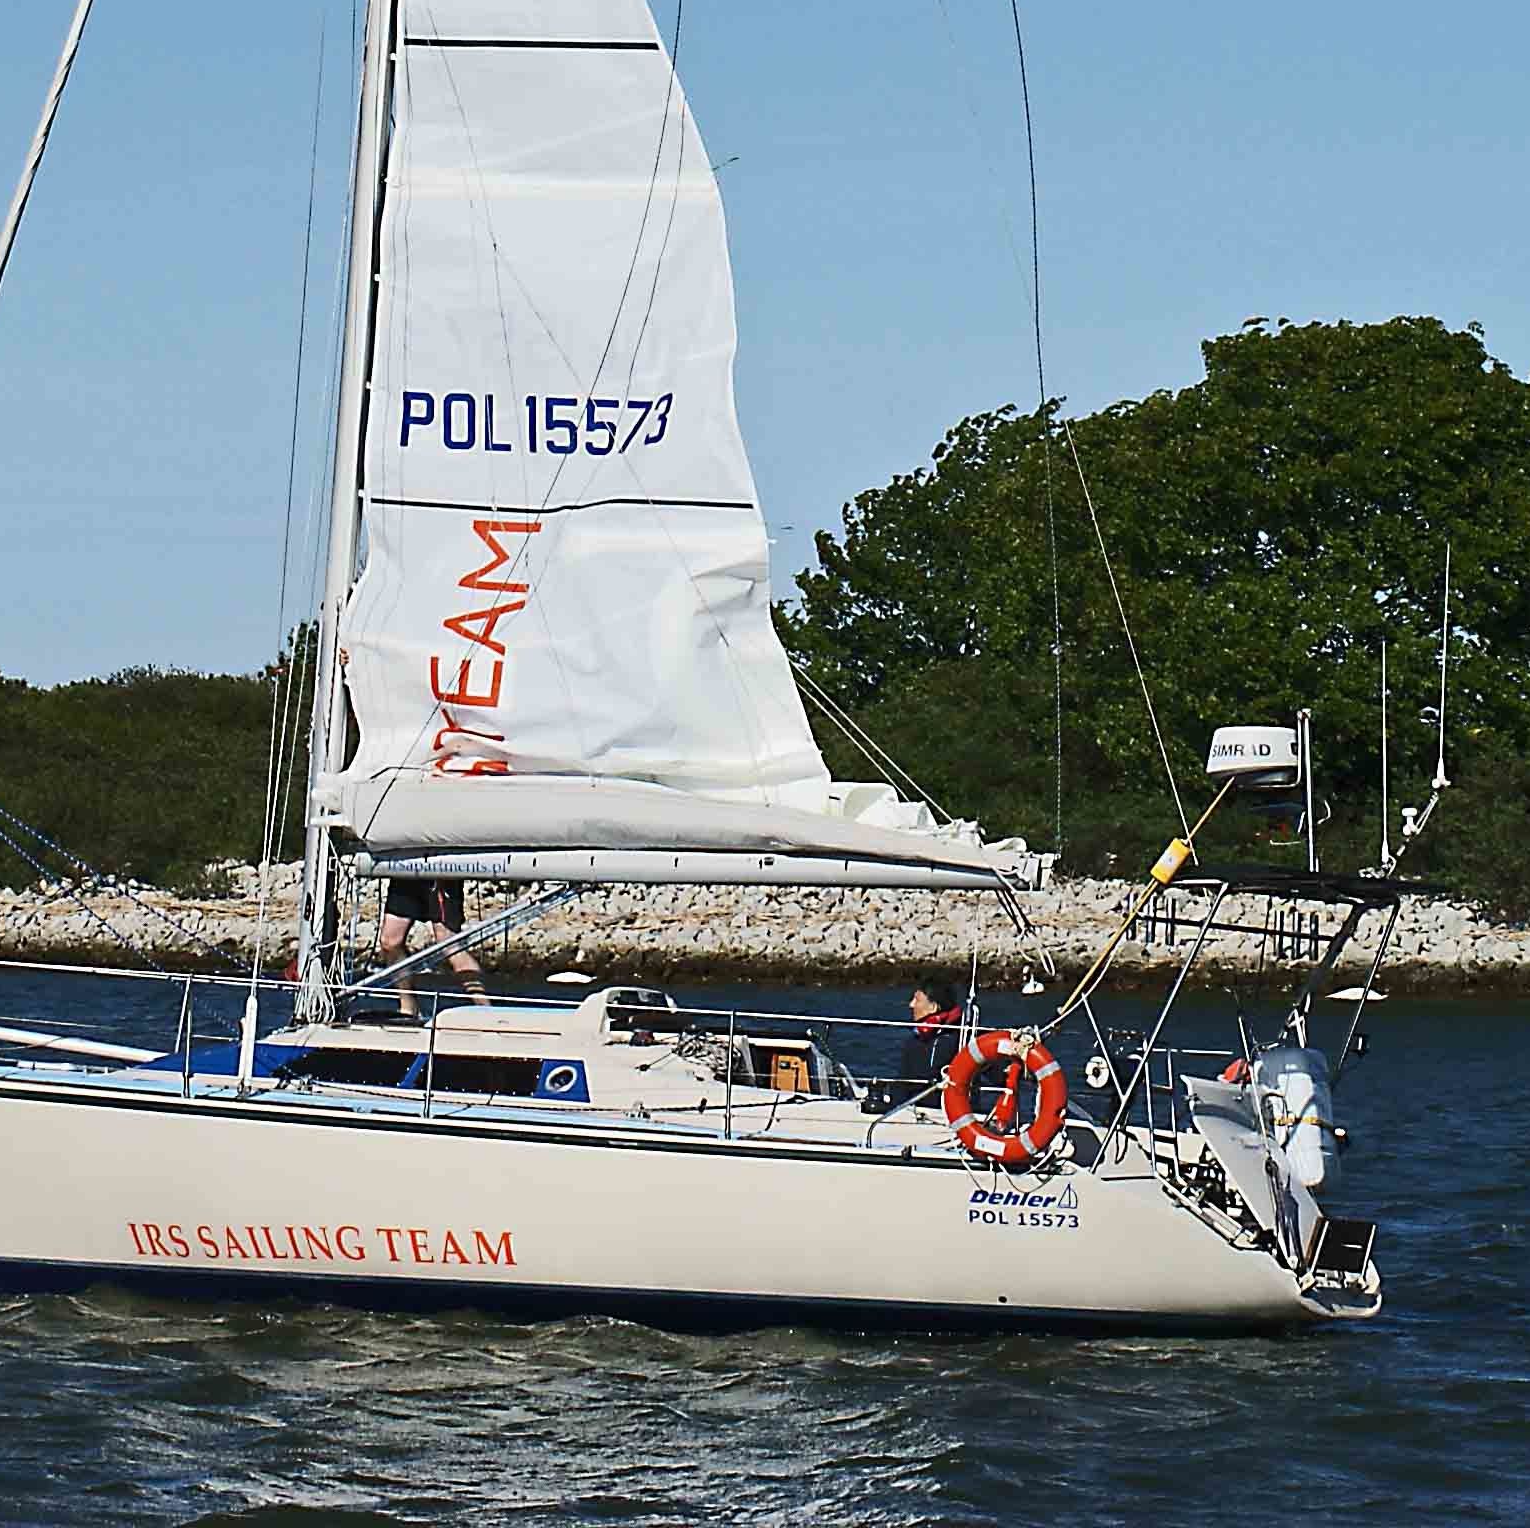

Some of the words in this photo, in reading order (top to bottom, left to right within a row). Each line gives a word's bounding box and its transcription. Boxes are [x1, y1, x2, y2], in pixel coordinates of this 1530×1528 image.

[969, 1189, 1057, 1208] Dehler
[968, 1209, 1009, 1225] POL
[1018, 1212, 1080, 1228] 15573
[126, 1222, 191, 1258] IRS
[195, 1224, 366, 1261] SAILING
[375, 1227, 518, 1266] TEAM
